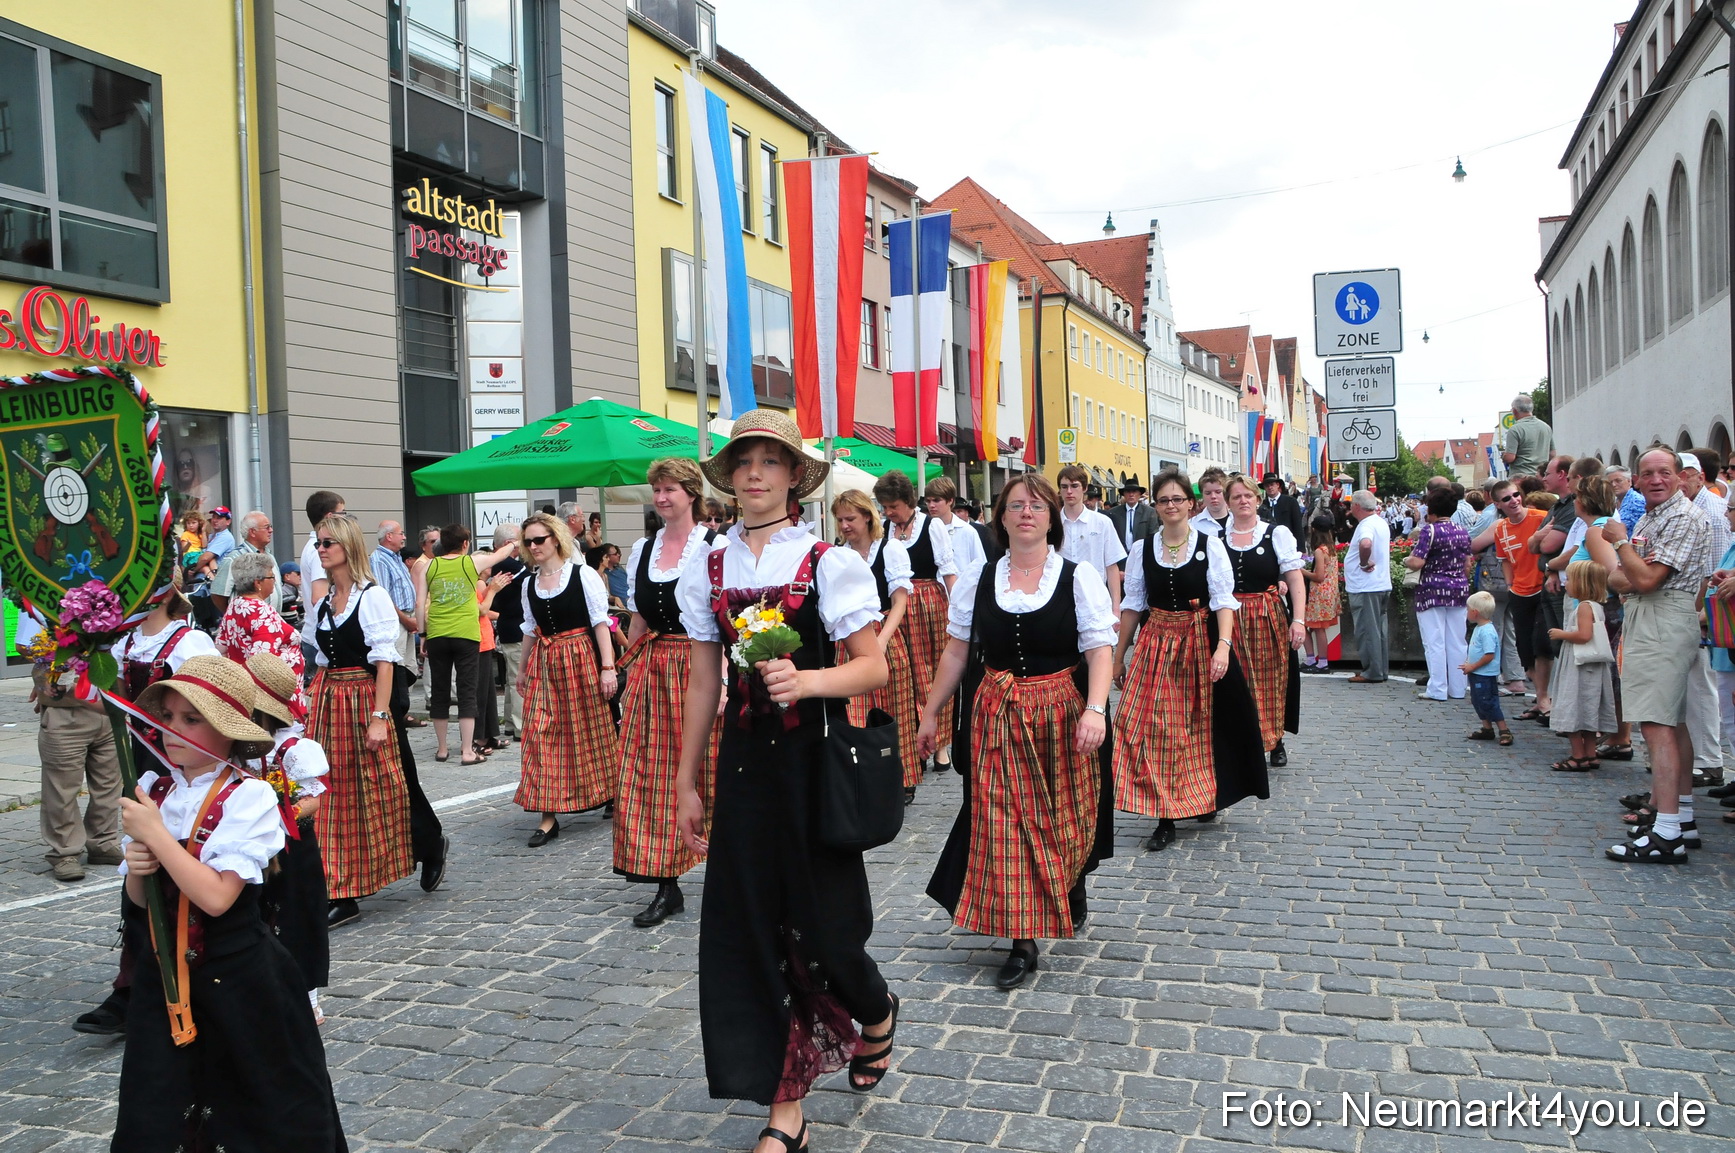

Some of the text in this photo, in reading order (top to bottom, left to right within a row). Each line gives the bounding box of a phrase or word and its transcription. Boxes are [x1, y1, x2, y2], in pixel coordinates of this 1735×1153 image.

[407, 178, 507, 238] altstadt
[409, 224, 508, 277] passage
[1337, 332, 1380, 347] ZONE
[1328, 363, 1391, 377] Lieferverkehr
[0, 383, 115, 424] LEINBURG
[1352, 391, 1369, 402] frei
[1351, 444, 1373, 455] frei
[481, 509, 524, 529] Martini
